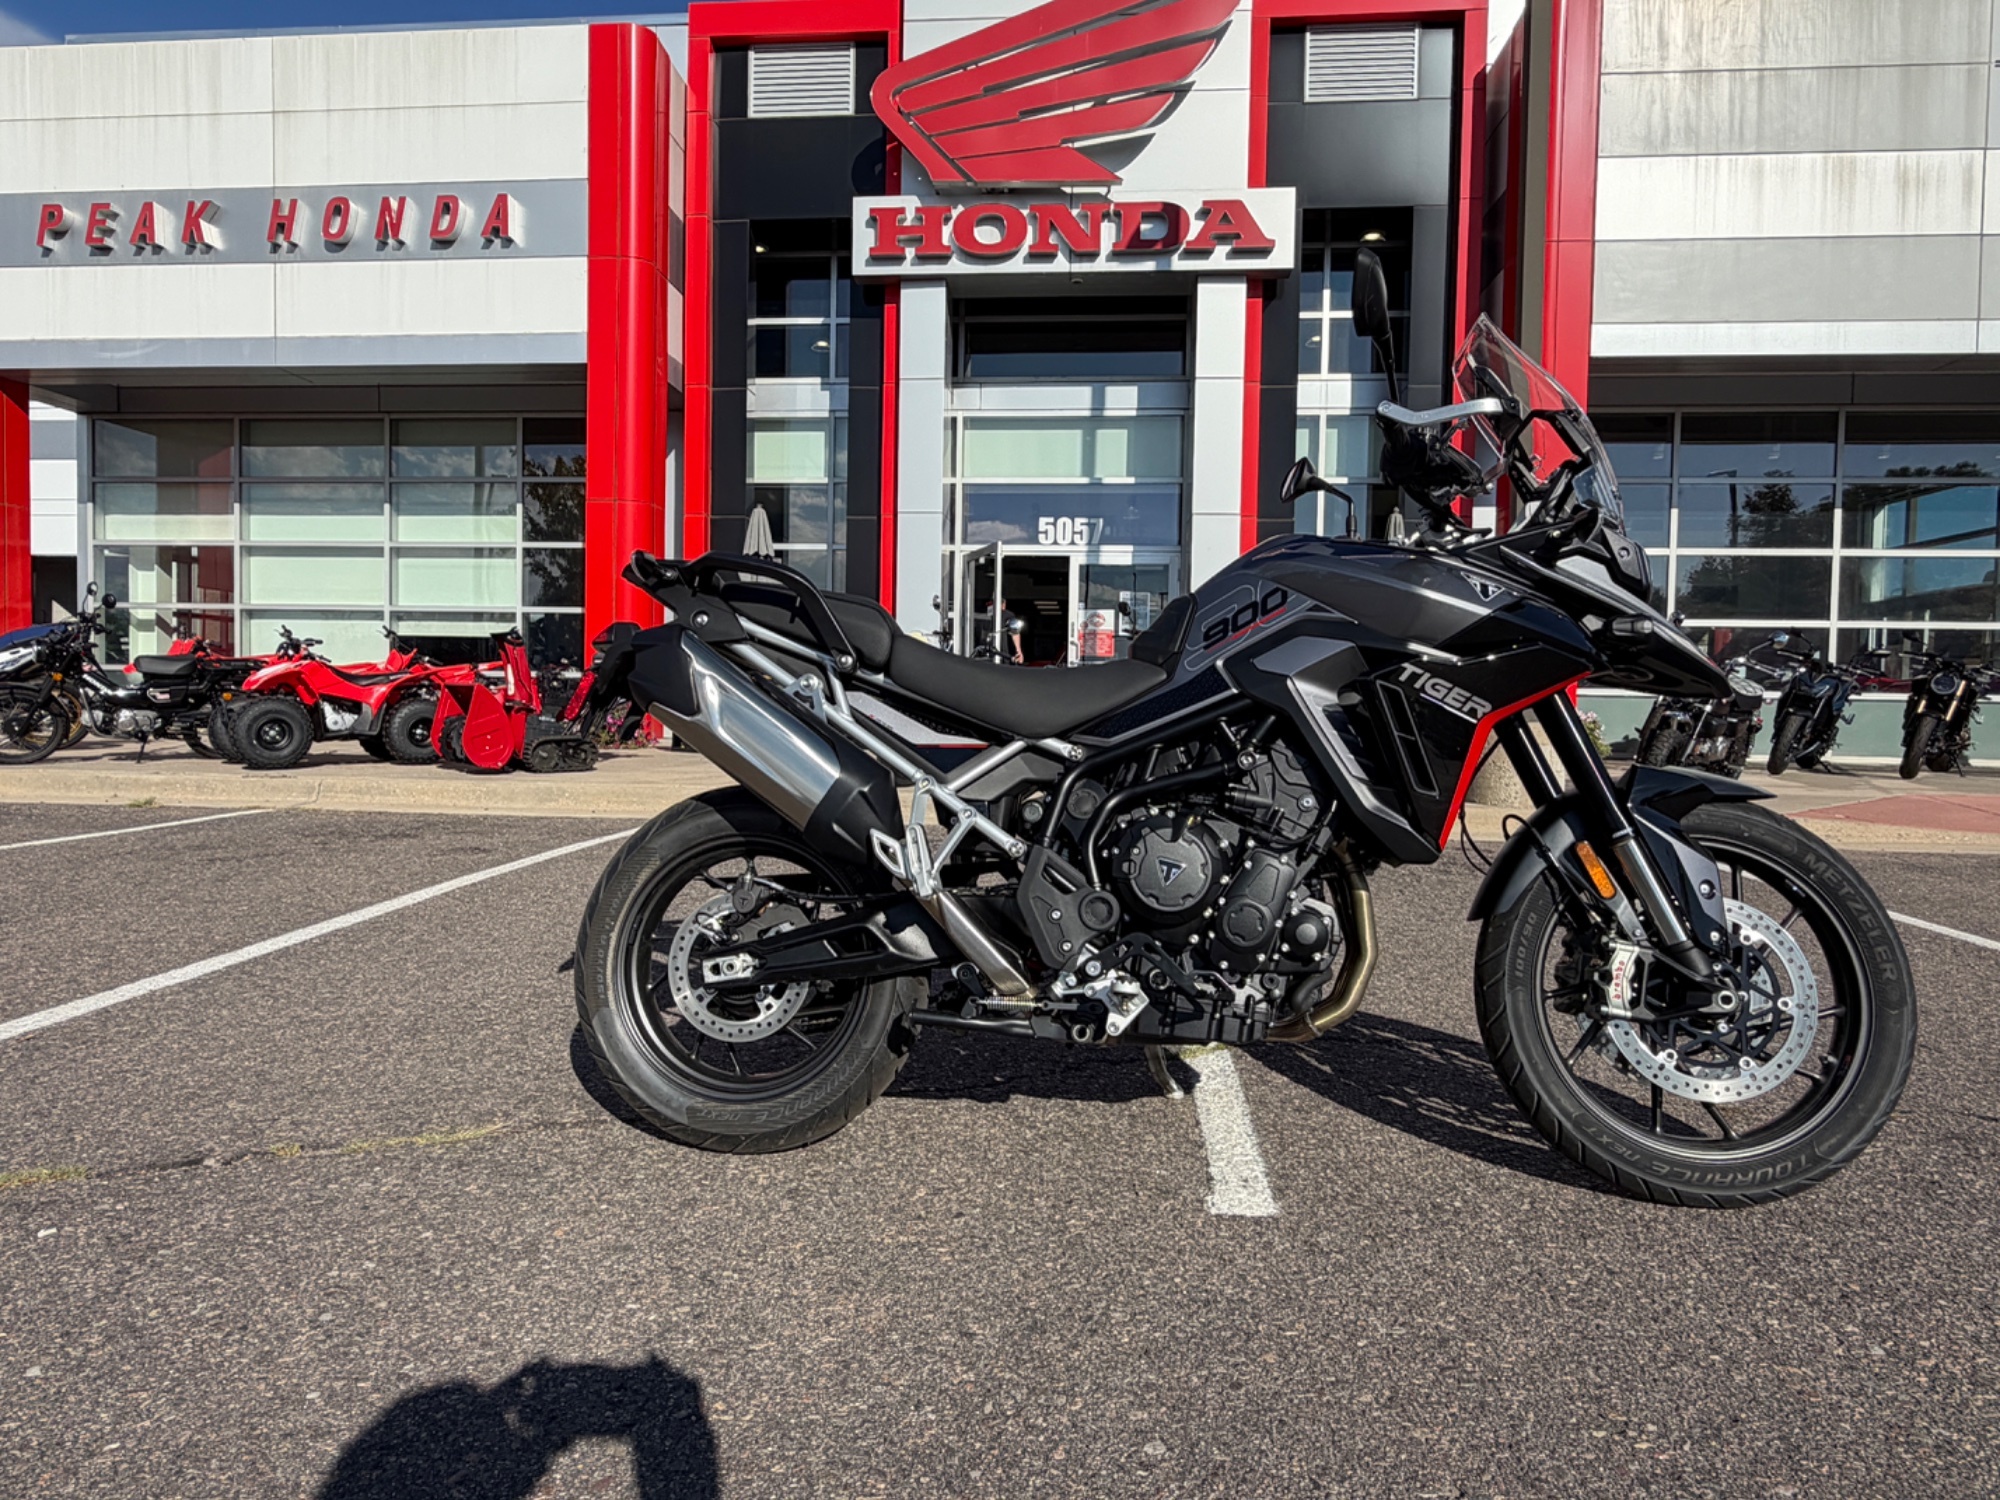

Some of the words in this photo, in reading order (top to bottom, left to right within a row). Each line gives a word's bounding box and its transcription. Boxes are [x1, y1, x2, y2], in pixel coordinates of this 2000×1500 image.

[36, 200, 216, 249] PEAK
[267, 193, 514, 244] HONDA
[868, 199, 1276, 257] HONDA
[1038, 516, 1104, 545] 5057
[1203, 586, 1288, 651] 900
[1398, 662, 1493, 719] TIGER
[1515, 912, 1537, 978] 100/90
[1802, 852, 1899, 982] METZELER
[1612, 960, 1626, 1000] brembo
[1650, 1153, 1812, 1187] TOURANCE
